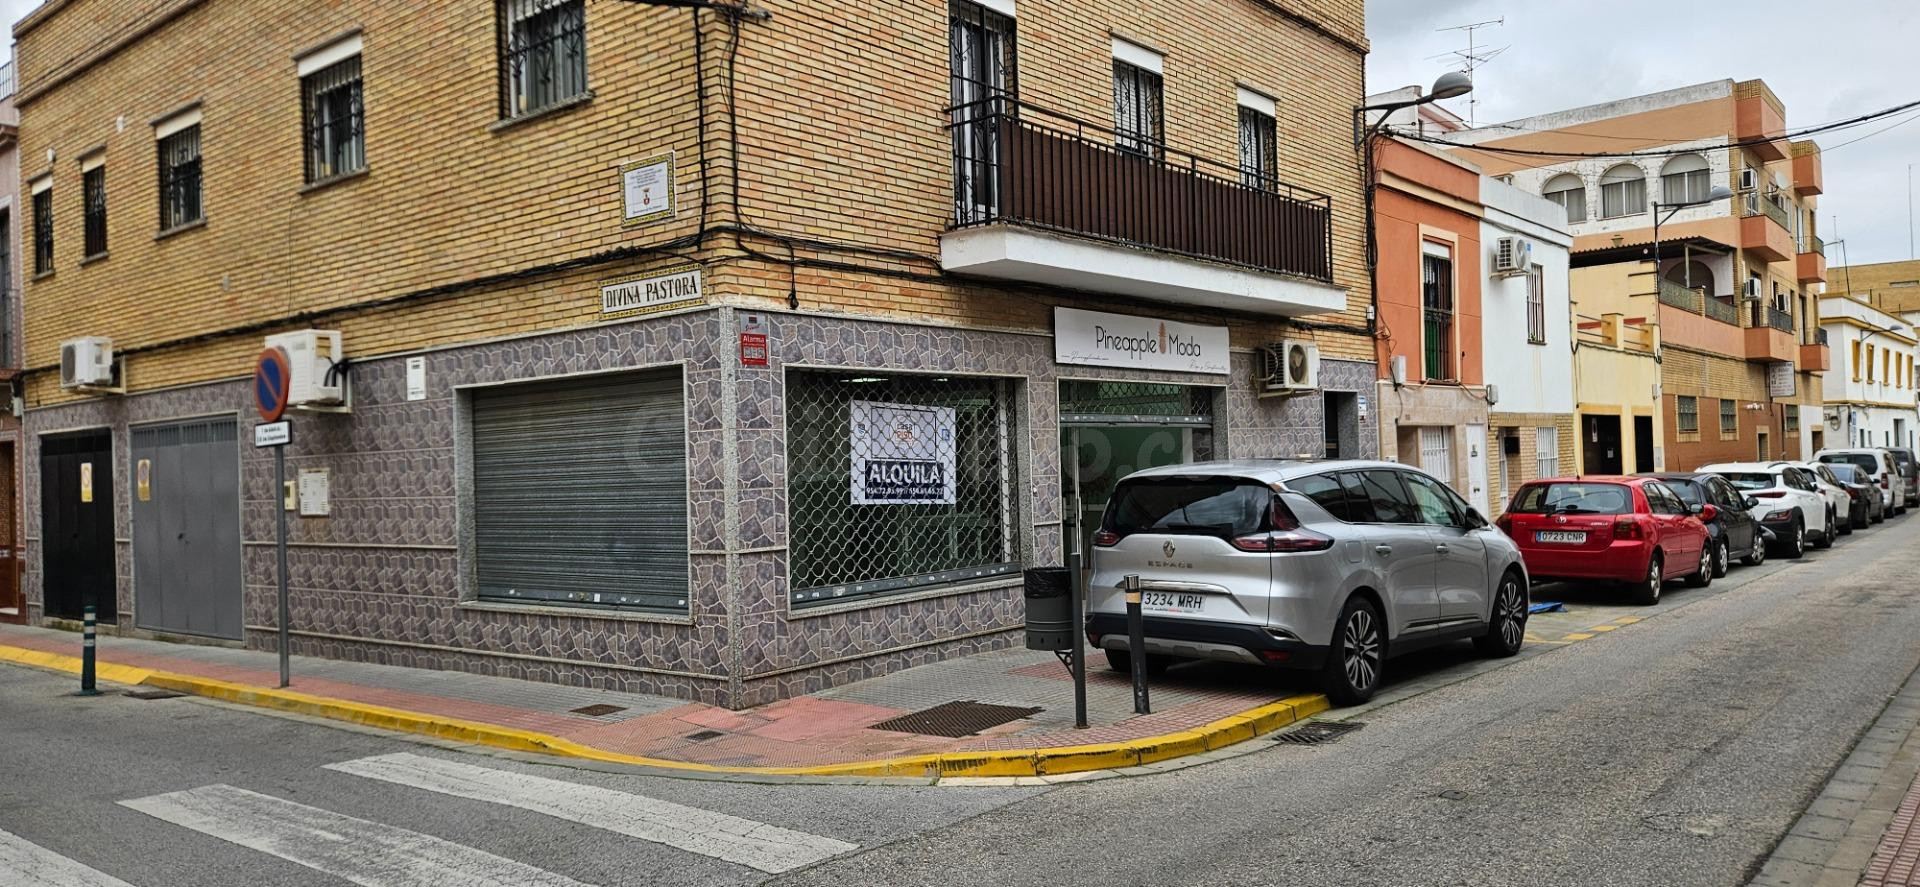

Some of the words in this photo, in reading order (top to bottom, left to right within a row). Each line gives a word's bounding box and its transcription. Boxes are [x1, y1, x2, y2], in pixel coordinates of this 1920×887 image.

[606, 285, 641, 308] DIVINA
[646, 275, 698, 302] PASTORA
[1095, 325, 1157, 361] Pineapple
[1168, 334, 1201, 357] Moda
[869, 463, 942, 485] ALQUILA
[1542, 532, 1565, 541] 0723
[1566, 532, 1584, 541] CNR
[1144, 592, 1174, 607] 3234
[1177, 594, 1203, 609] MRH
